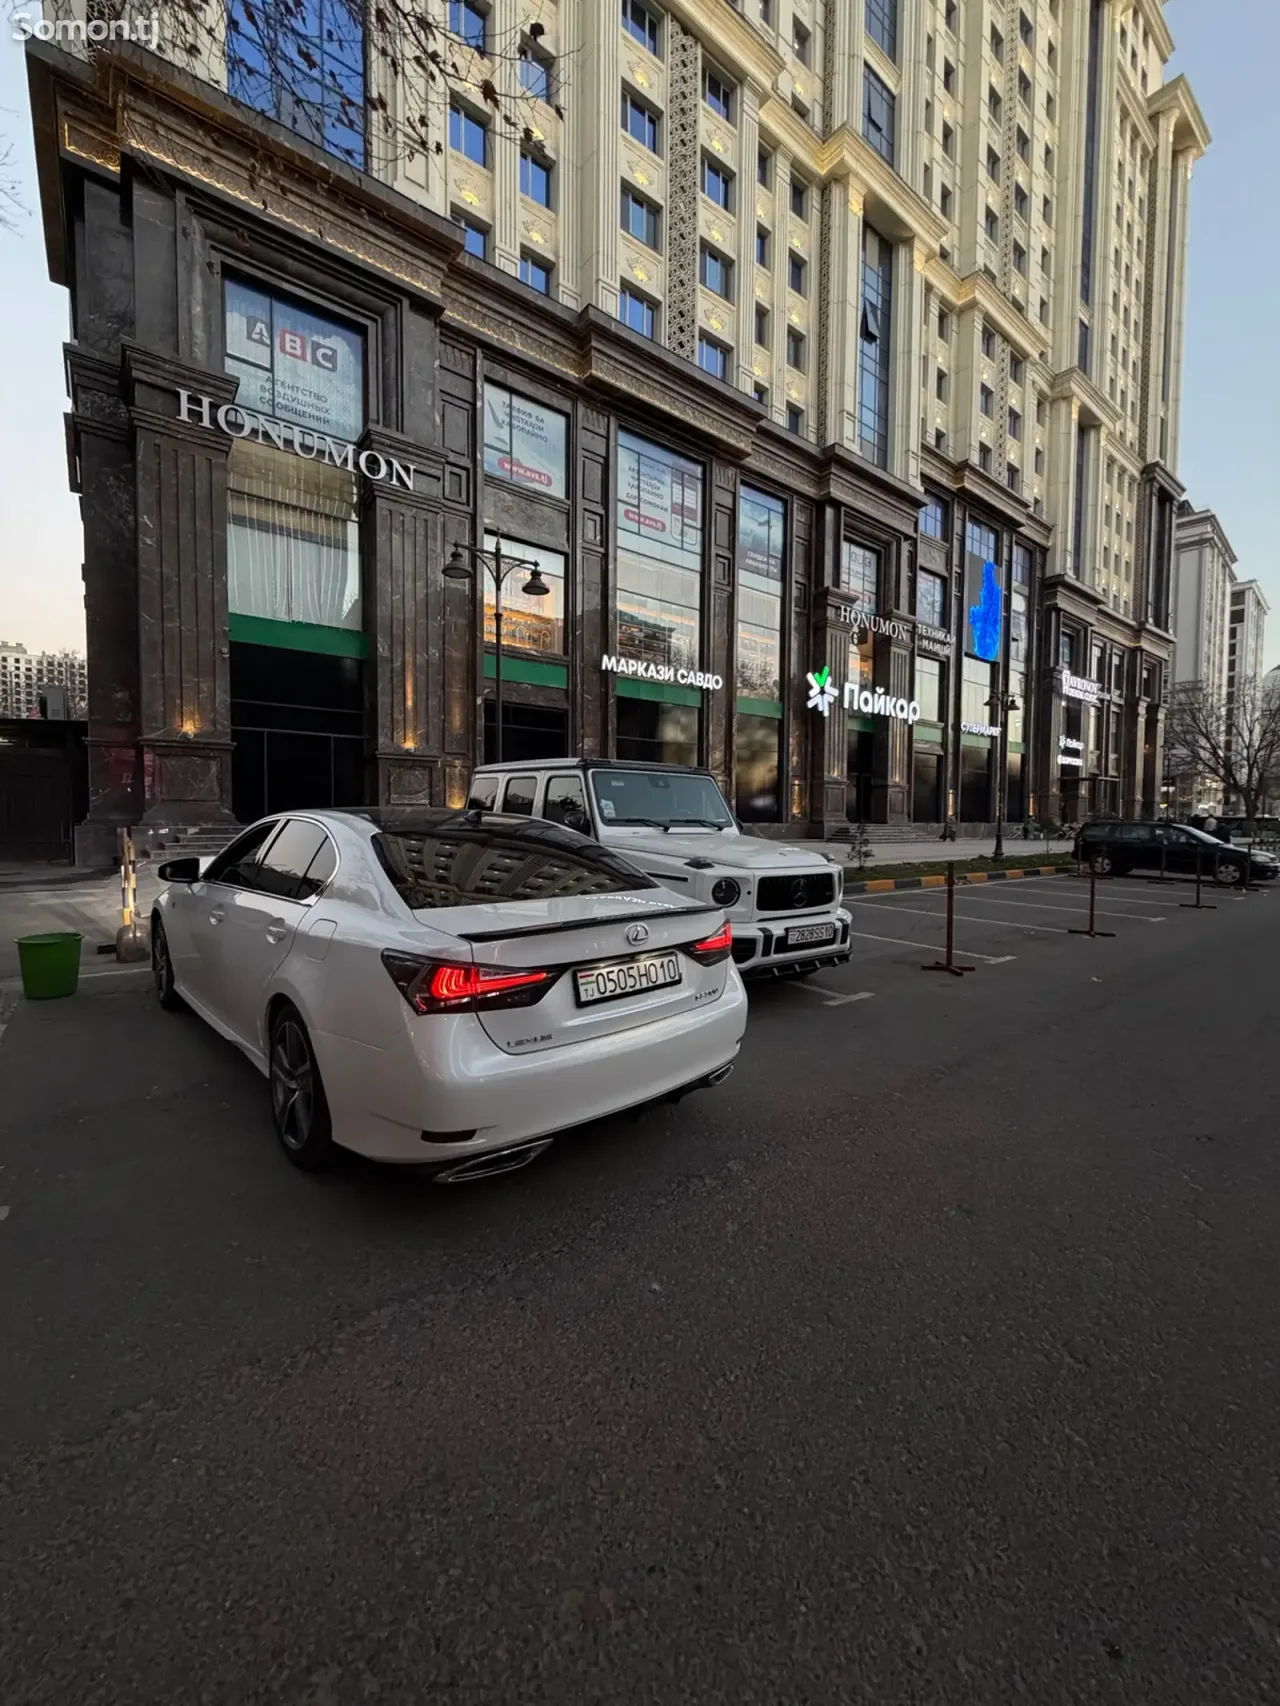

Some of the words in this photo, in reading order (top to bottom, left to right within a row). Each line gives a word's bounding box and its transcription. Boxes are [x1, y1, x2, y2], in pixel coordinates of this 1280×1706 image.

[259, 384, 331, 416] ВОЗДУШНЫХ
[265, 375, 328, 404] АГЕНТСТВО
[259, 396, 330, 426] СООБЩЕНИЙ
[176, 387, 416, 492] HONUMON
[503, 462, 548, 484] www.avs.tj
[840, 605, 908, 641] HONUMON
[601, 654, 675, 682] МАРКАЗИ
[677, 669, 723, 690] САВДО
[843, 681, 920, 725] Пайкар
[583, 988, 595, 998] TJ
